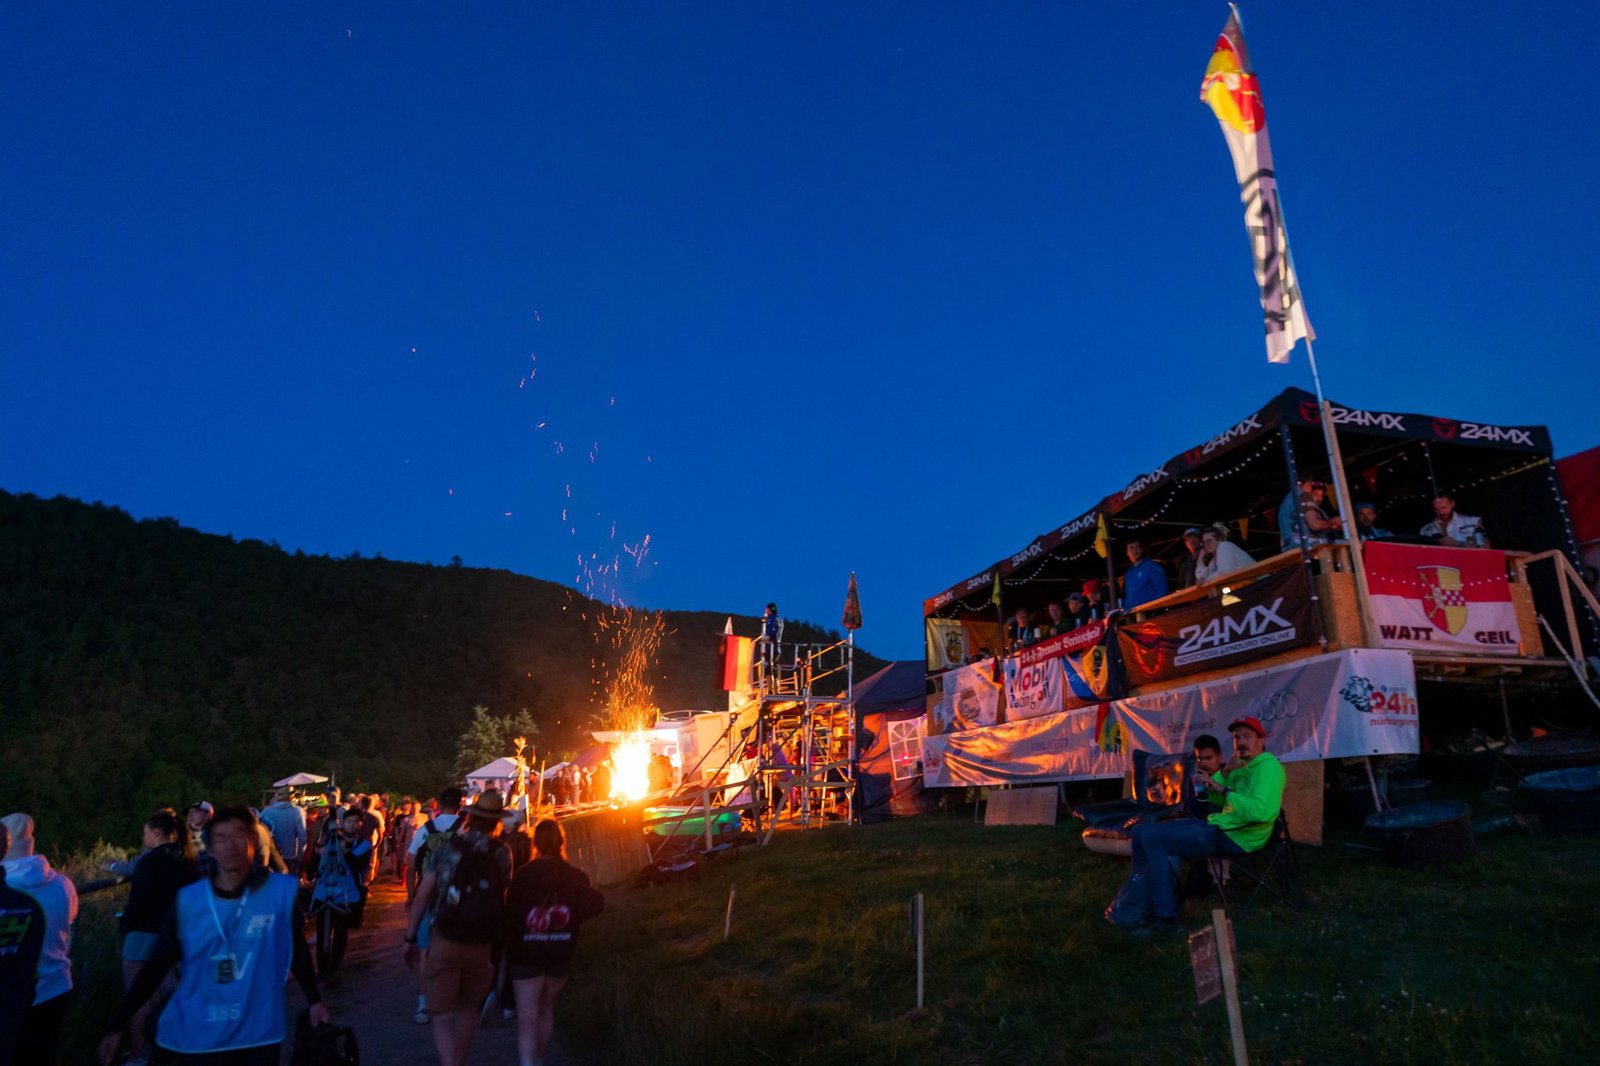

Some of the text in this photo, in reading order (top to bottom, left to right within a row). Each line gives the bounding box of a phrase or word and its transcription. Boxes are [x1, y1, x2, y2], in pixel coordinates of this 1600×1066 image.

[1331, 408, 1406, 431] 24MX
[1202, 413, 1262, 455] 24MX
[1460, 423, 1535, 446] 24MX
[1123, 465, 1169, 500] 24MX
[1061, 511, 1096, 540] 24MX
[1012, 540, 1043, 567] 24MX
[1177, 596, 1292, 655] 24MX
[1260, 631, 1291, 645] ONLINE
[1380, 624, 1517, 645] WATT GEIL
[1372, 690, 1416, 715] 24h
